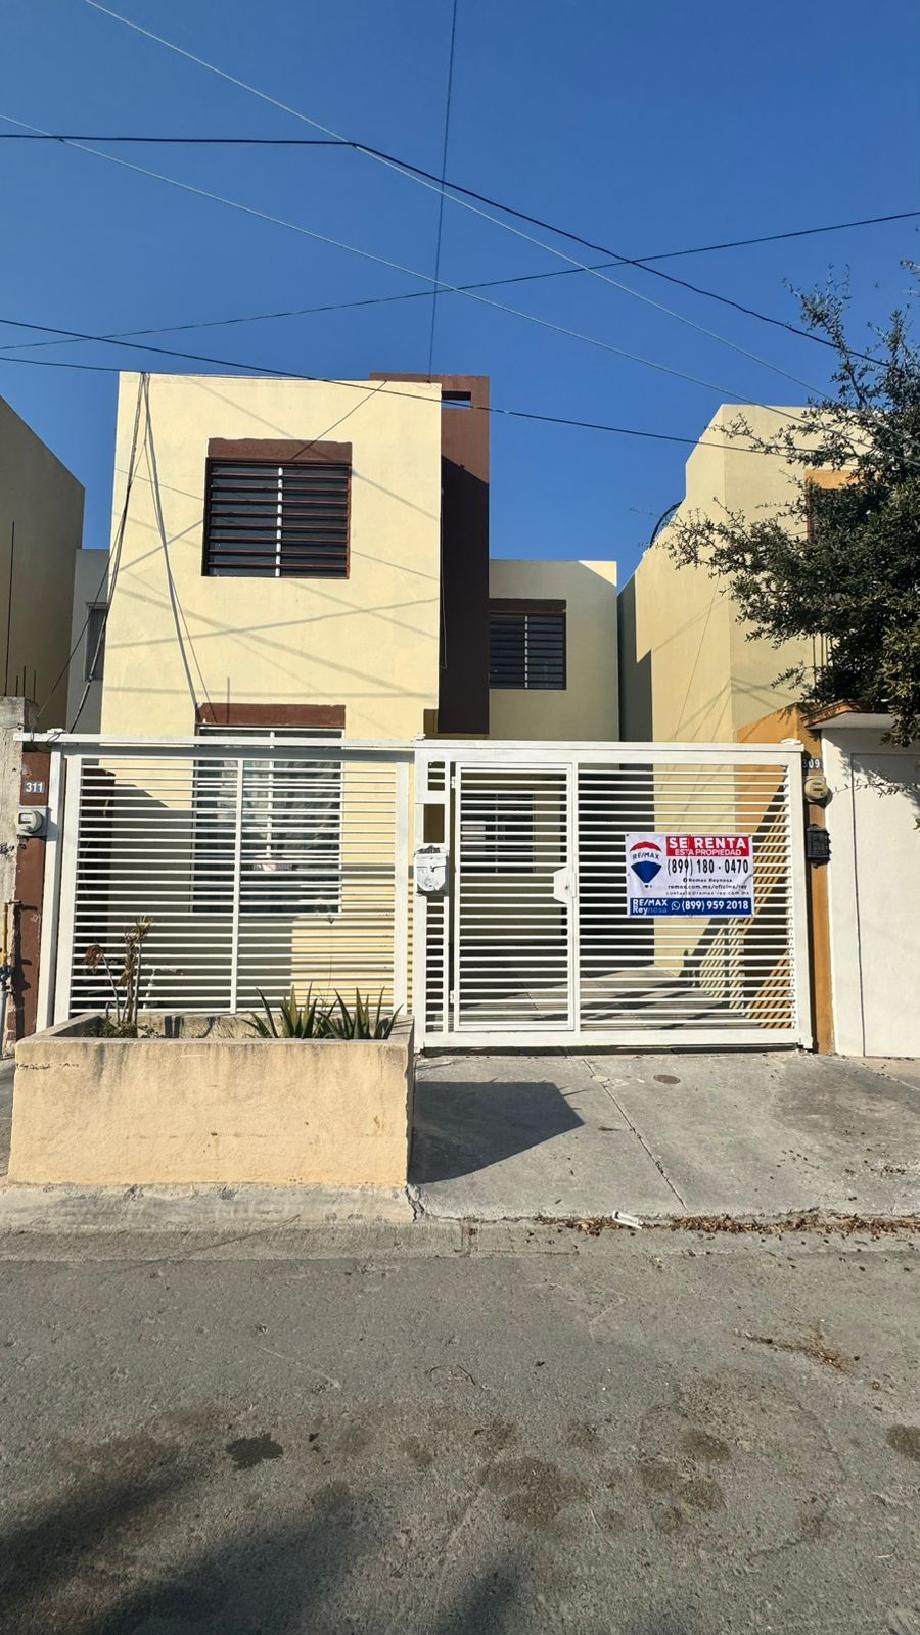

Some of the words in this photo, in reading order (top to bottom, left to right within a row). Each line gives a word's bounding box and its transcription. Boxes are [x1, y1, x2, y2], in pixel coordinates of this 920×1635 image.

[26, 782, 43, 793] 311
[669, 837, 687, 849] SE
[694, 837, 746, 849] RENTA
[632, 851, 660, 861] RE/MAX
[667, 859, 693, 876] (899)
[696, 859, 715, 874] 180
[724, 859, 749, 874] 0470
[632, 899, 668, 907] RE/MAX
[682, 900, 705, 912] (899)
[706, 901, 724, 909] 959
[726, 900, 749, 909] 2018
